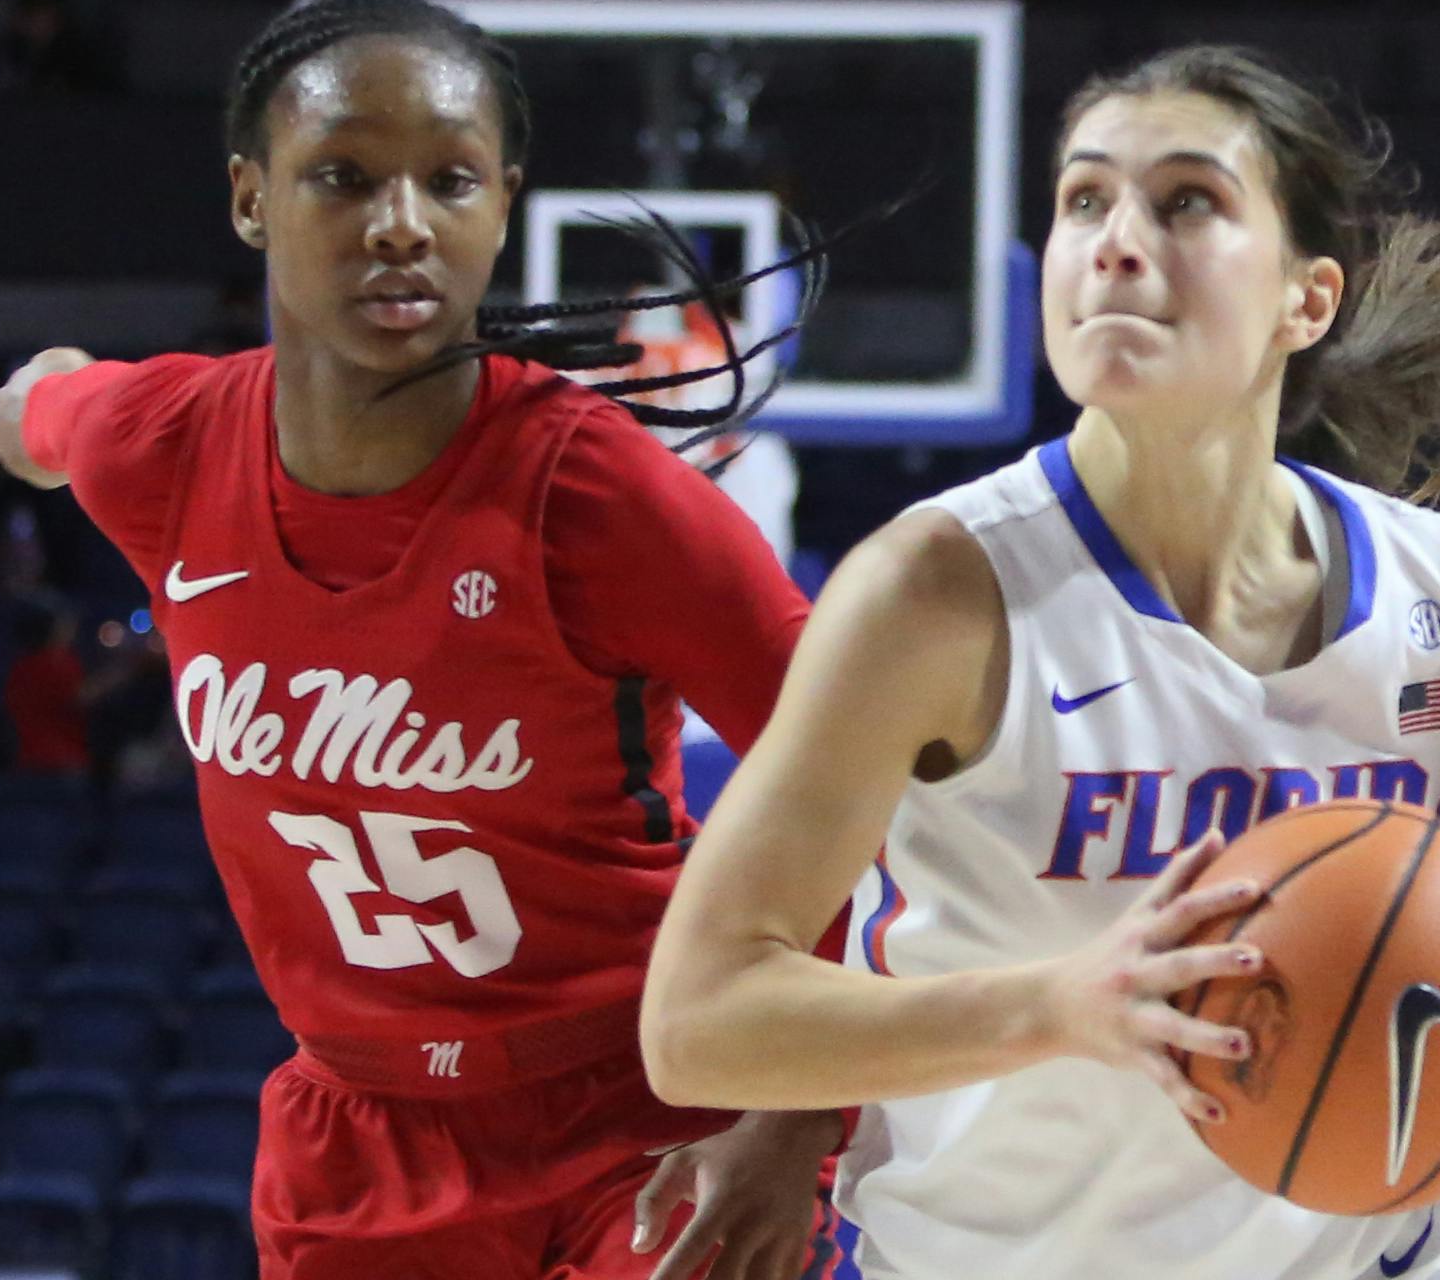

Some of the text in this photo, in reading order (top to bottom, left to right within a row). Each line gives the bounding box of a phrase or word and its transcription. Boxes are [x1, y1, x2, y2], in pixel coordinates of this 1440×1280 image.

[451, 569, 499, 620] SEC
[177, 652, 535, 792] Ole Miss
[267, 809, 526, 980] 25
